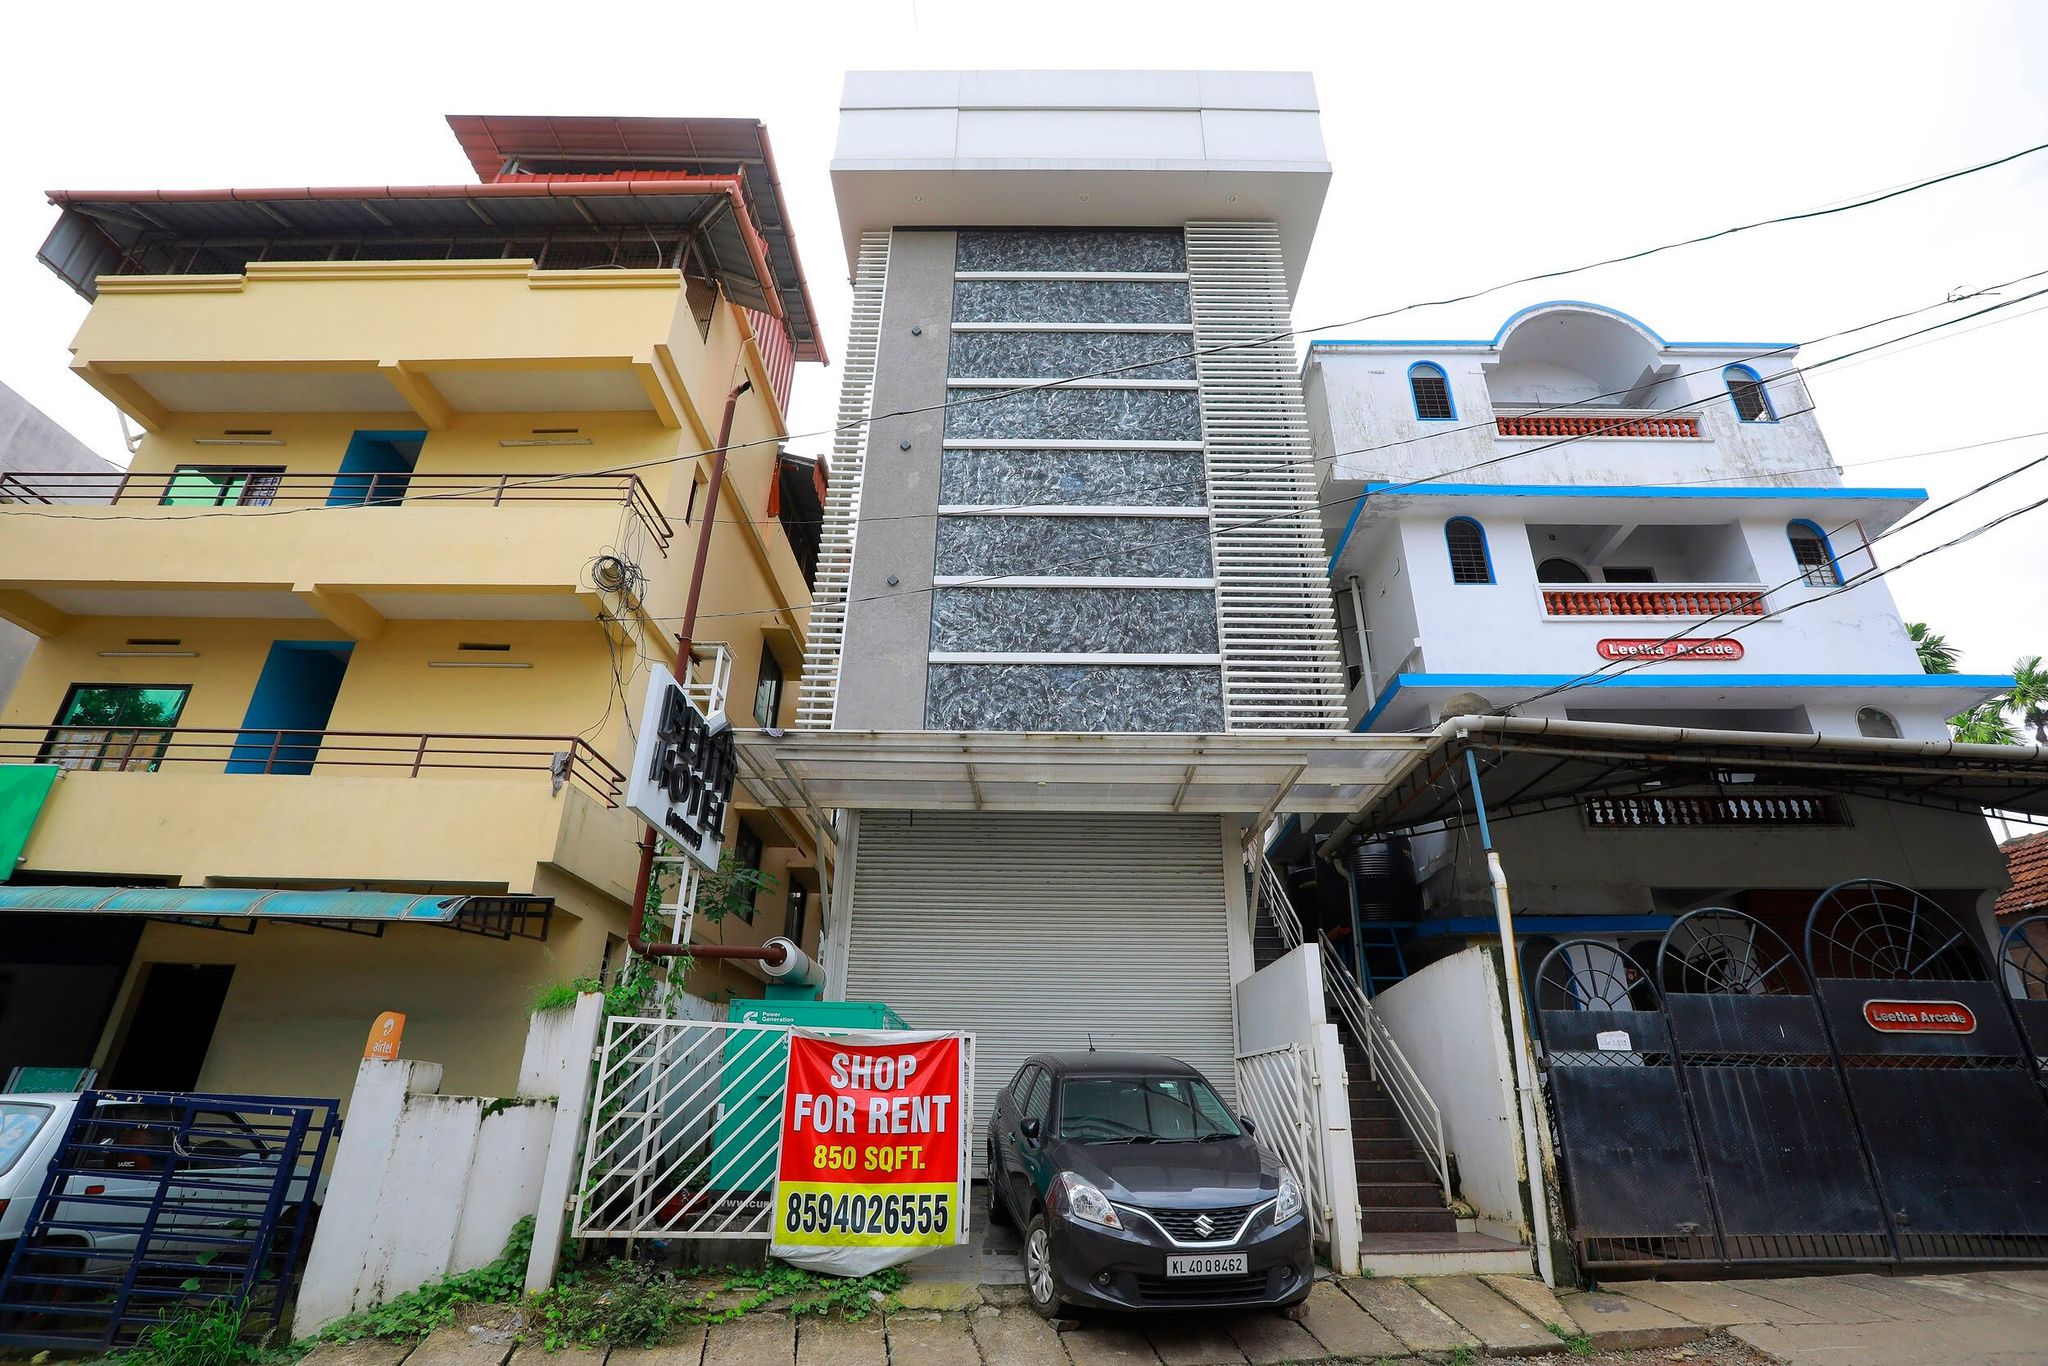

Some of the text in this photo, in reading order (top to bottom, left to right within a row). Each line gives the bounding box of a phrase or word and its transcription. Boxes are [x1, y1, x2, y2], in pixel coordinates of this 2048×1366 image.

[1608, 643, 1735, 655] Leetha Arcade
[1871, 1010, 1967, 1024] Leetha Arcade
[372, 1040, 393, 1054] airtel
[830, 1052, 917, 1091] SHOP
[793, 1093, 951, 1134] FOR RENT
[813, 1145, 926, 1173] 850 SQFT.
[786, 1192, 949, 1235] 8594026555
[1214, 1258, 1243, 1272] 8462
